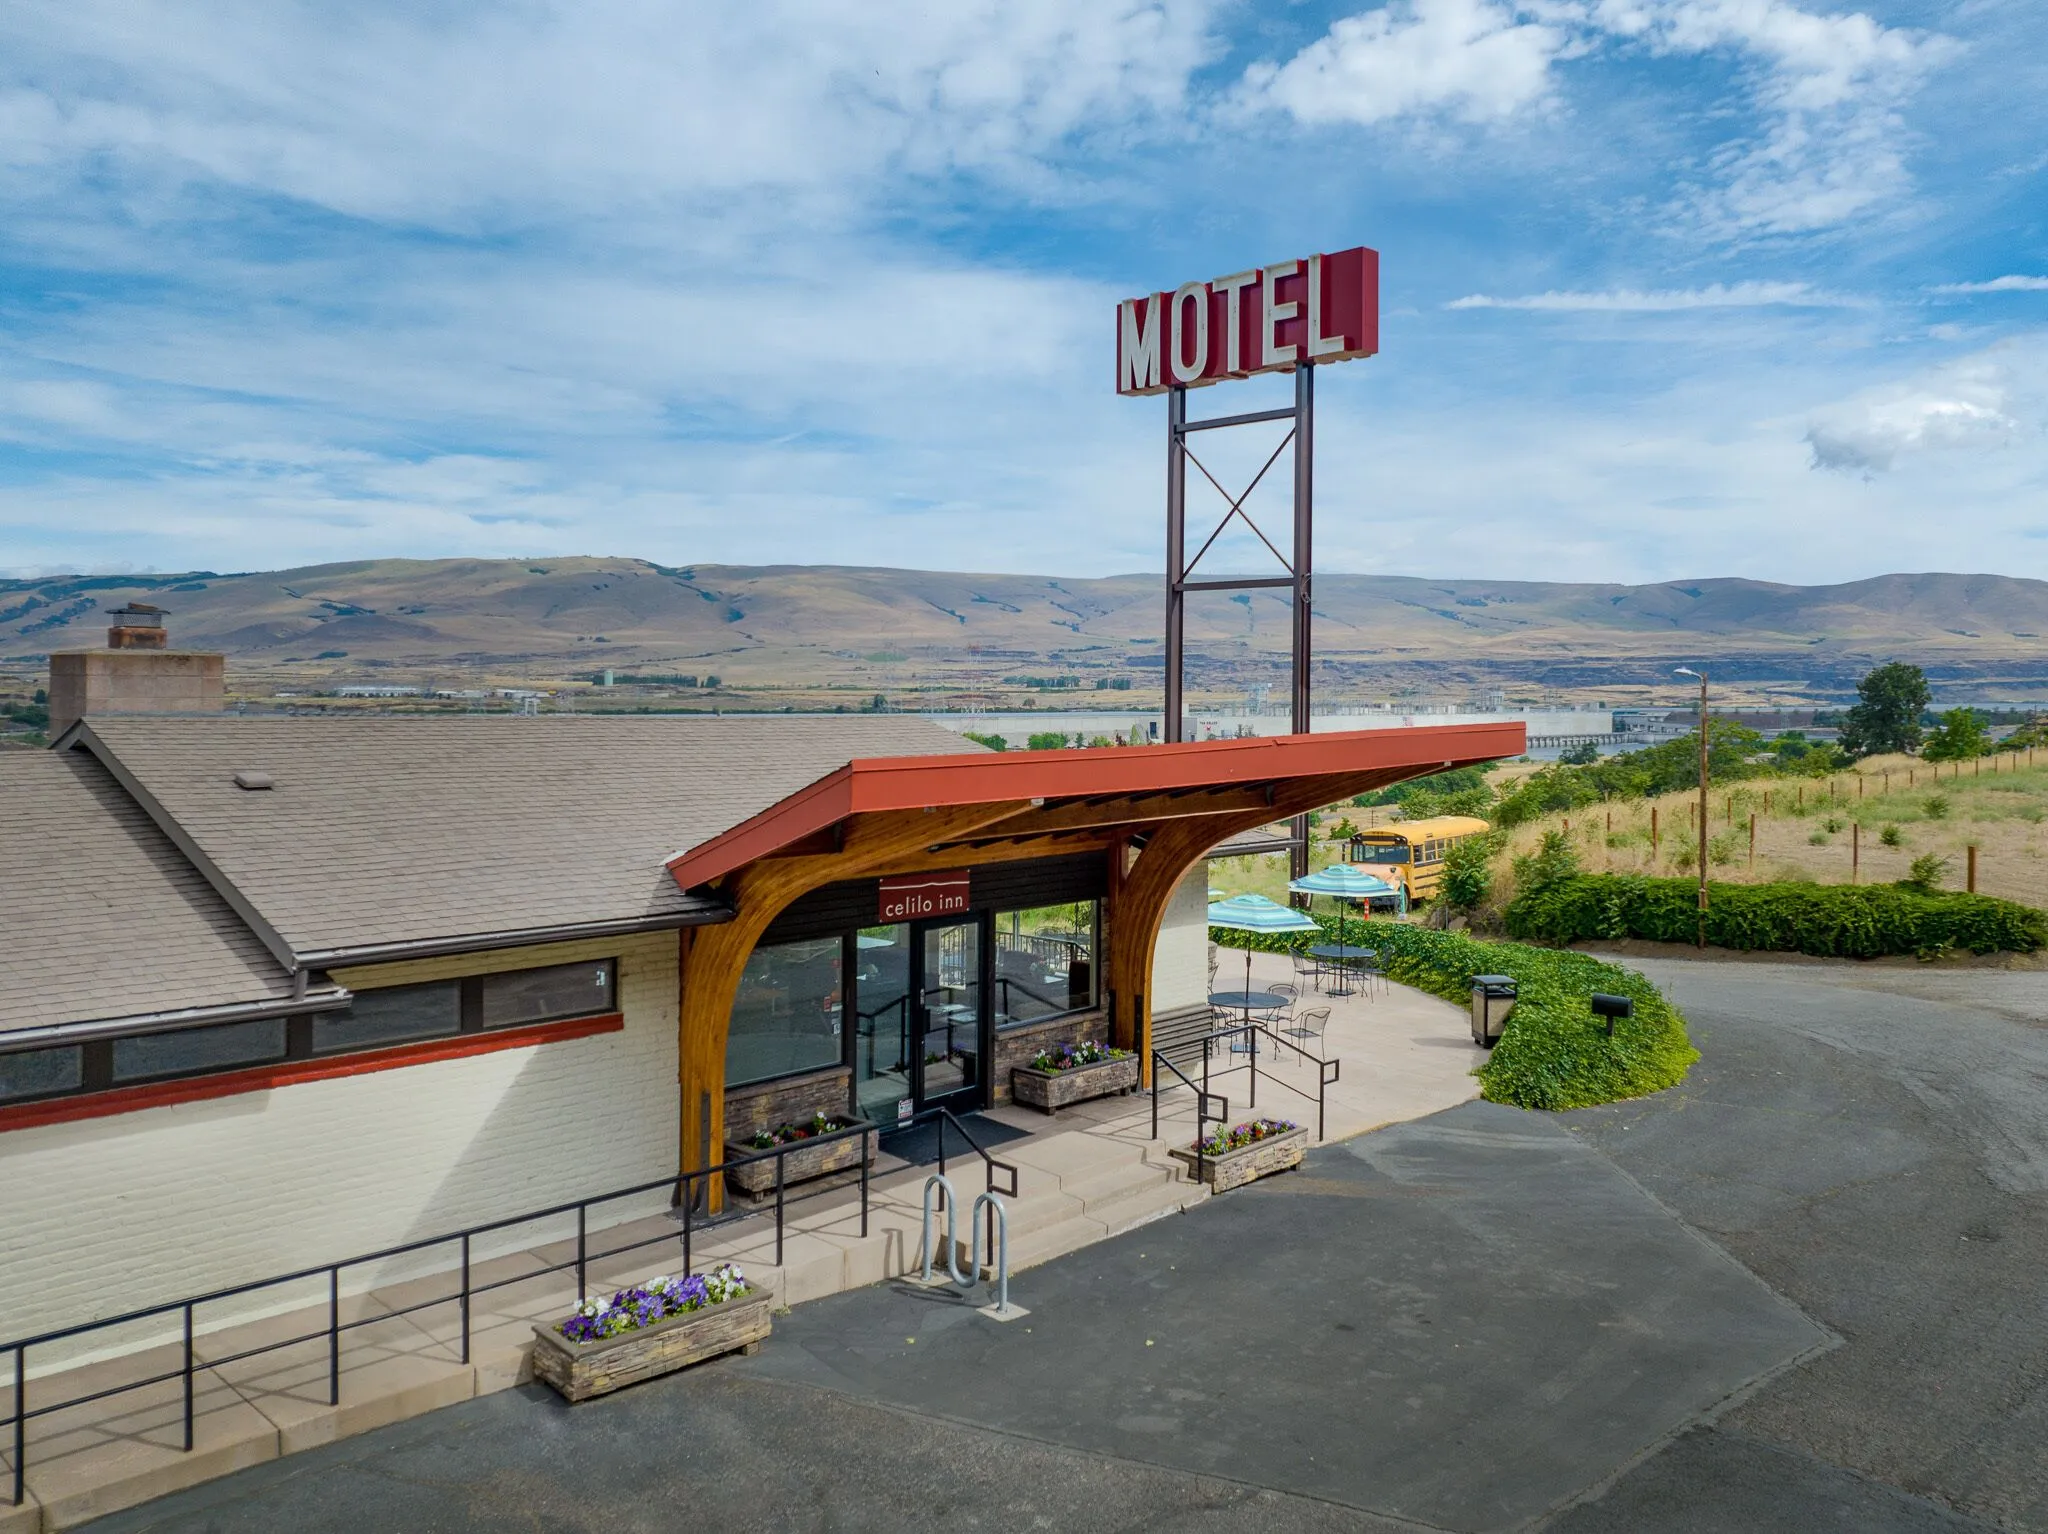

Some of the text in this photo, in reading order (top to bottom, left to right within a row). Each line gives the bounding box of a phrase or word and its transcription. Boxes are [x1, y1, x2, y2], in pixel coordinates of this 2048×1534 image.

[1121, 253, 1345, 392] MOTEL
[885, 894, 963, 917] celilo inn
